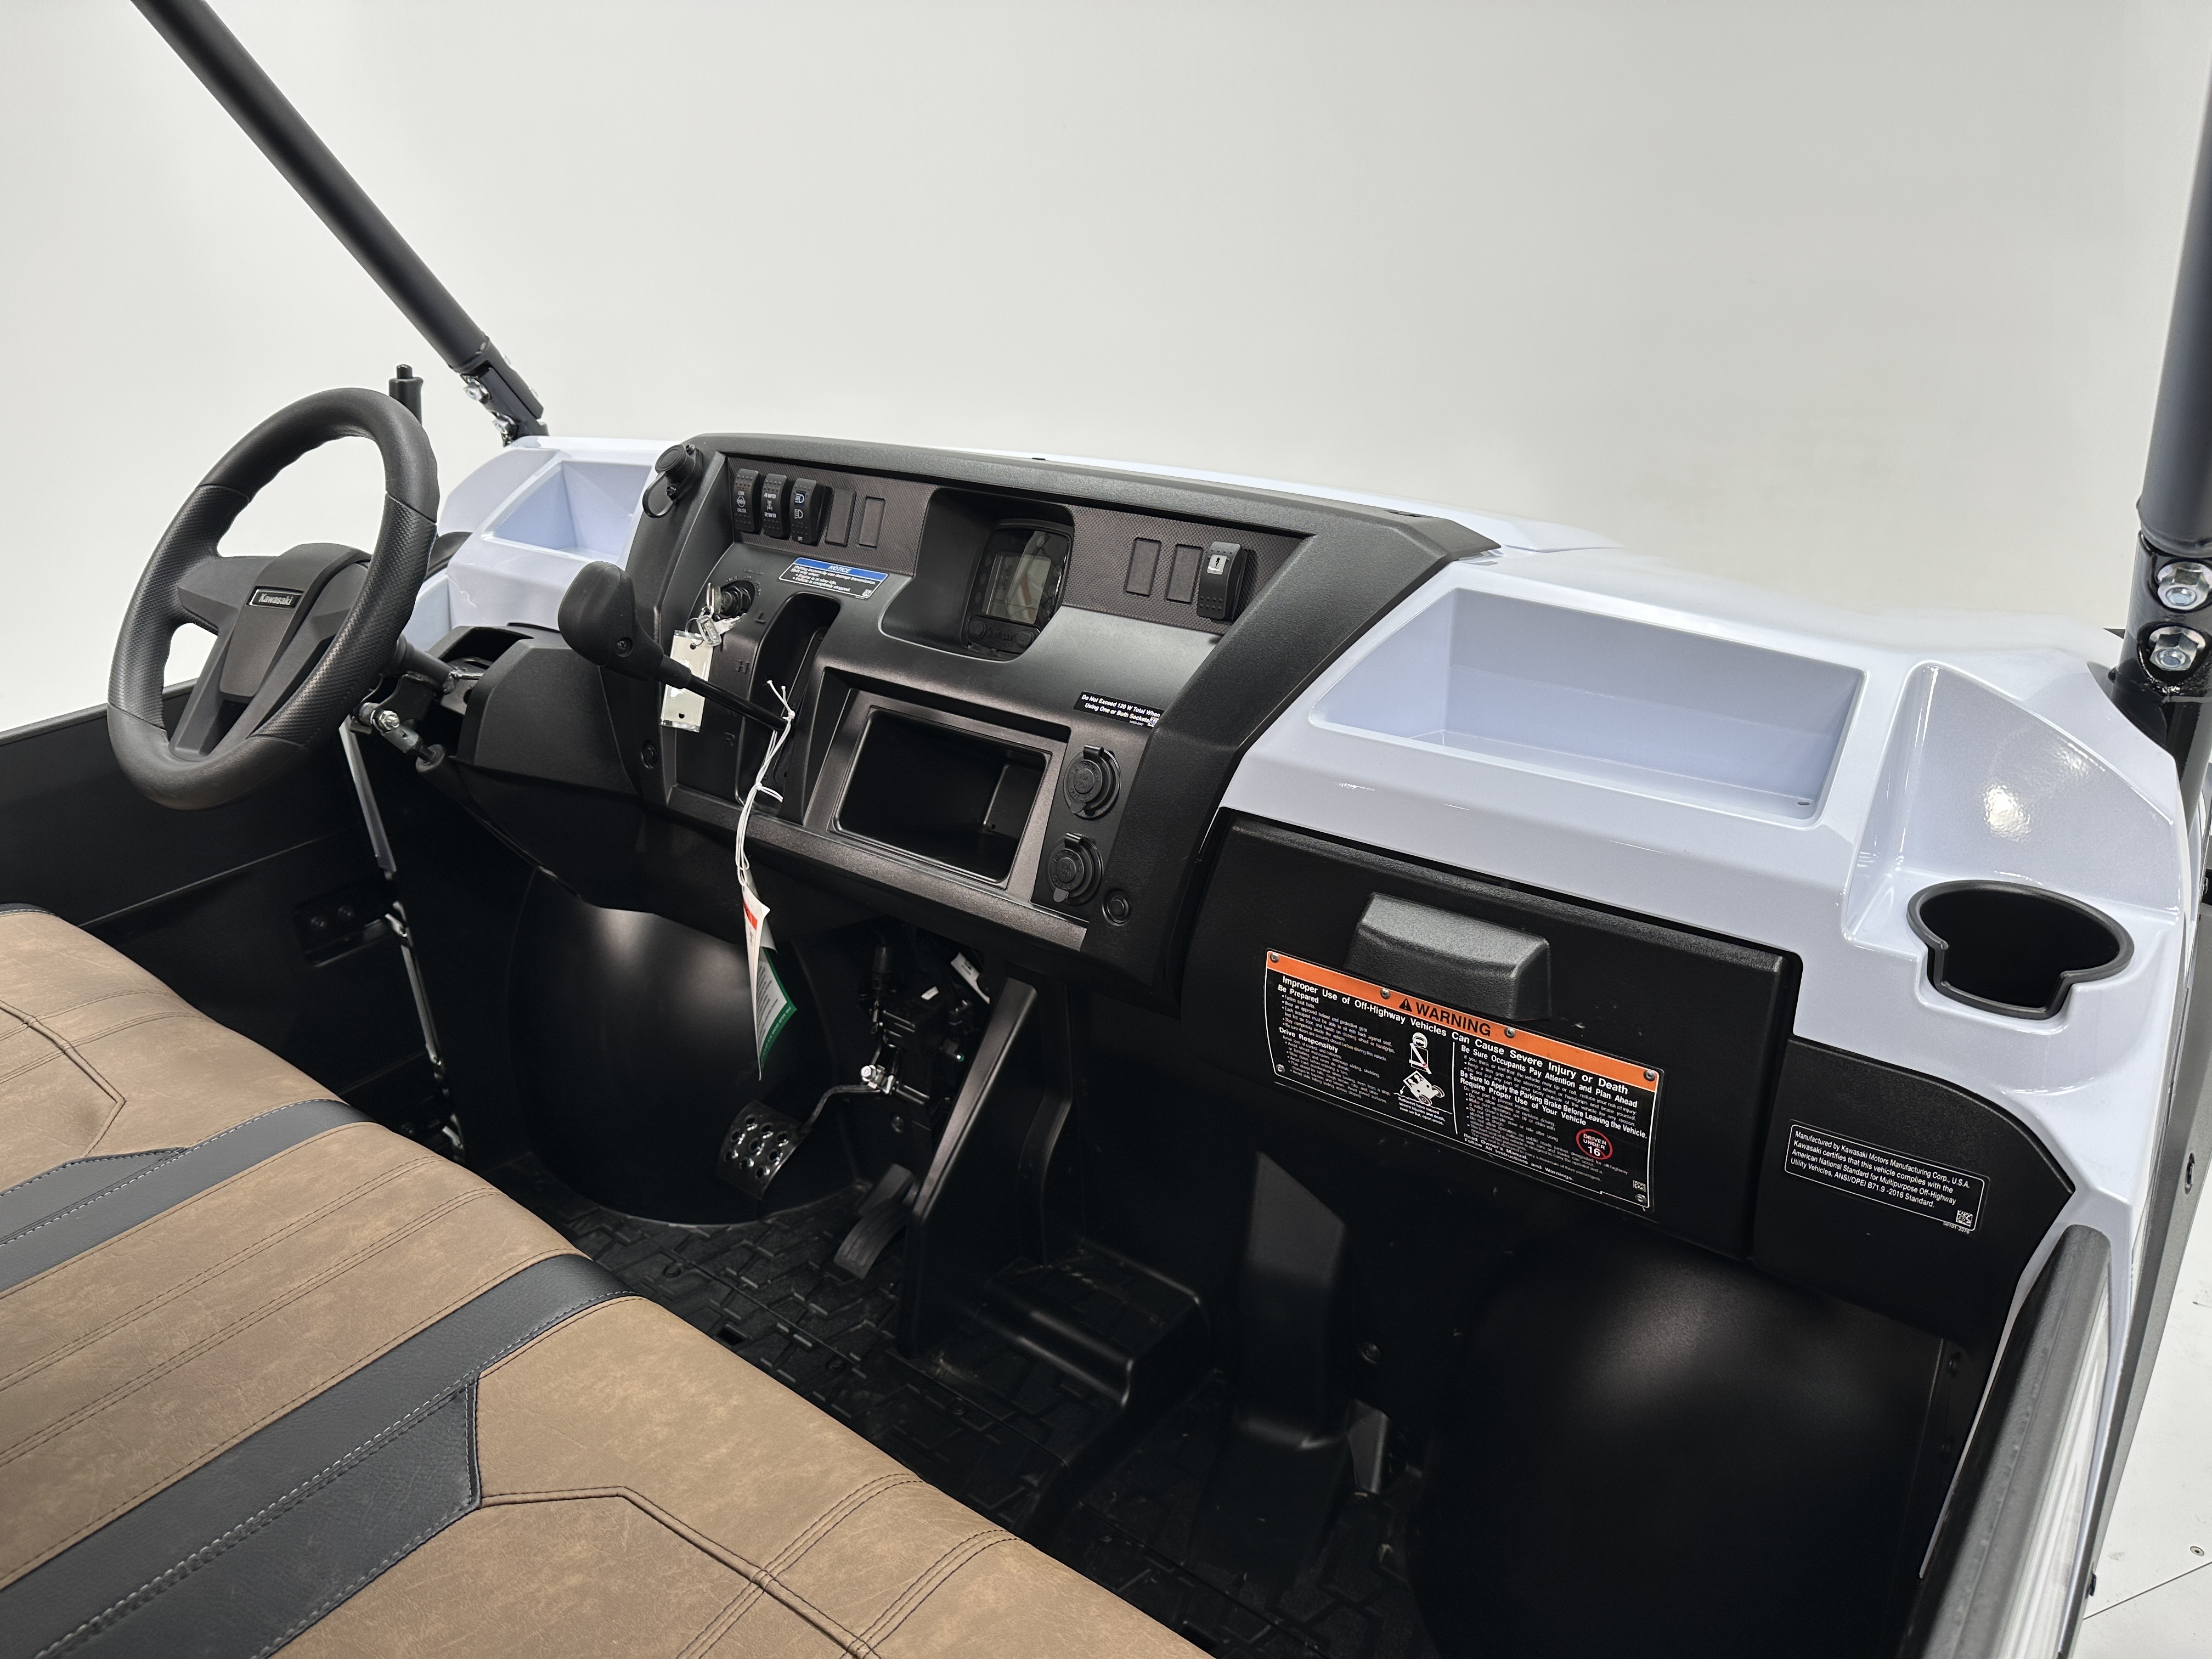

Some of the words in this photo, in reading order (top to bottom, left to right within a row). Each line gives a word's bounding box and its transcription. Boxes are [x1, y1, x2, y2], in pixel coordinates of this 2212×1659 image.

[259, 594, 294, 606] Kawasaki
[736, 660, 749, 674] H
[1085, 703, 1099, 711] Using
[1129, 713, 1151, 723] Sockets
[1098, 698, 1117, 707] Exceed
[1278, 984, 1286, 992] Be
[1290, 989, 1319, 1003] Prepared
[1416, 1002, 1490, 1036] WARNING
[1279, 1027, 1295, 1037] Drive
[1299, 1034, 1338, 1053] Responsibly
[1283, 975, 1318, 994] Improper
[1323, 989, 1338, 1000] Use
[1355, 1000, 1406, 1024] Off-Highway
[1410, 1018, 1446, 1036] Vehicles
[1452, 1032, 1469, 1043] Can
[1475, 1039, 1504, 1054] Cause
[1510, 1050, 1543, 1067] Severe
[1549, 1062, 1577, 1079] Injury
[1599, 1078, 1628, 1094] Death
[1462, 1045, 1470, 1053] Be
[1473, 1049, 1488, 1059] Sure
[1491, 1055, 1525, 1071] Occupants
[1530, 1067, 1542, 1077] Pay
[1545, 1073, 1575, 1087] Attention
[1579, 1085, 1592, 1093] and
[1595, 1088, 1611, 1099] Plan
[1615, 1095, 1637, 1108] Ahead
[1460, 1077, 1485, 1091] Require
[1489, 1087, 1511, 1099] Proper
[1515, 1096, 1527, 1105] Use
[1542, 1105, 1558, 1115] Your
[1561, 1111, 1586, 1125] Vehicle
[1469, 1073, 1482, 1083] Sure
[1491, 1081, 1508, 1092] Apply
[1509, 1087, 1519, 1095] the
[1520, 1090, 1542, 1104] Parking
[1544, 1098, 1561, 1109] Brake
[1564, 1105, 1583, 1117] Before
[1585, 1112, 1609, 1127] Leaving
[1611, 1121, 1621, 1130] the
[1623, 1124, 1647, 1138] Vehicle.
[1583, 1134, 1606, 1146] DRIVER
[1583, 1139, 1605, 1150] UNDER
[1588, 1146, 1600, 1156] 16
[1794, 1140, 1821, 1154] Kawasaki
[1823, 1150, 1846, 1161] certifies
[1848, 1157, 1860, 1166] that
[1861, 1161, 1872, 1169] this
[1874, 1166, 1895, 1176] vehicle
[1897, 1173, 1926, 1185] complies
[1943, 1185, 1953, 1193] the
[1795, 1131, 1832, 1147] Manufactured
[1833, 1143, 1840, 1151] by
[1841, 1145, 1867, 1158] Kawasaki
[1869, 1153, 1888, 1165] Motors
[1890, 1159, 1931, 1178] Manufacturing
[1952, 1177, 1970, 1188] U.S.A.
[1791, 1158, 1807, 1169] Utility
[1808, 1163, 1832, 1177] Vehicles,
[1834, 1172, 1866, 1186] ANSI/OPEI
[1867, 1182, 1885, 1192] B71.9
[1905, 1193, 1934, 1207] Standard.
[1792, 1149, 1818, 1162] American
[1819, 1158, 1842, 1170] National
[1843, 1165, 1869, 1178] Standard
[1880, 1176, 1918, 1193] Multipurpose
[1920, 1188, 1956, 1205] Off-Highway
